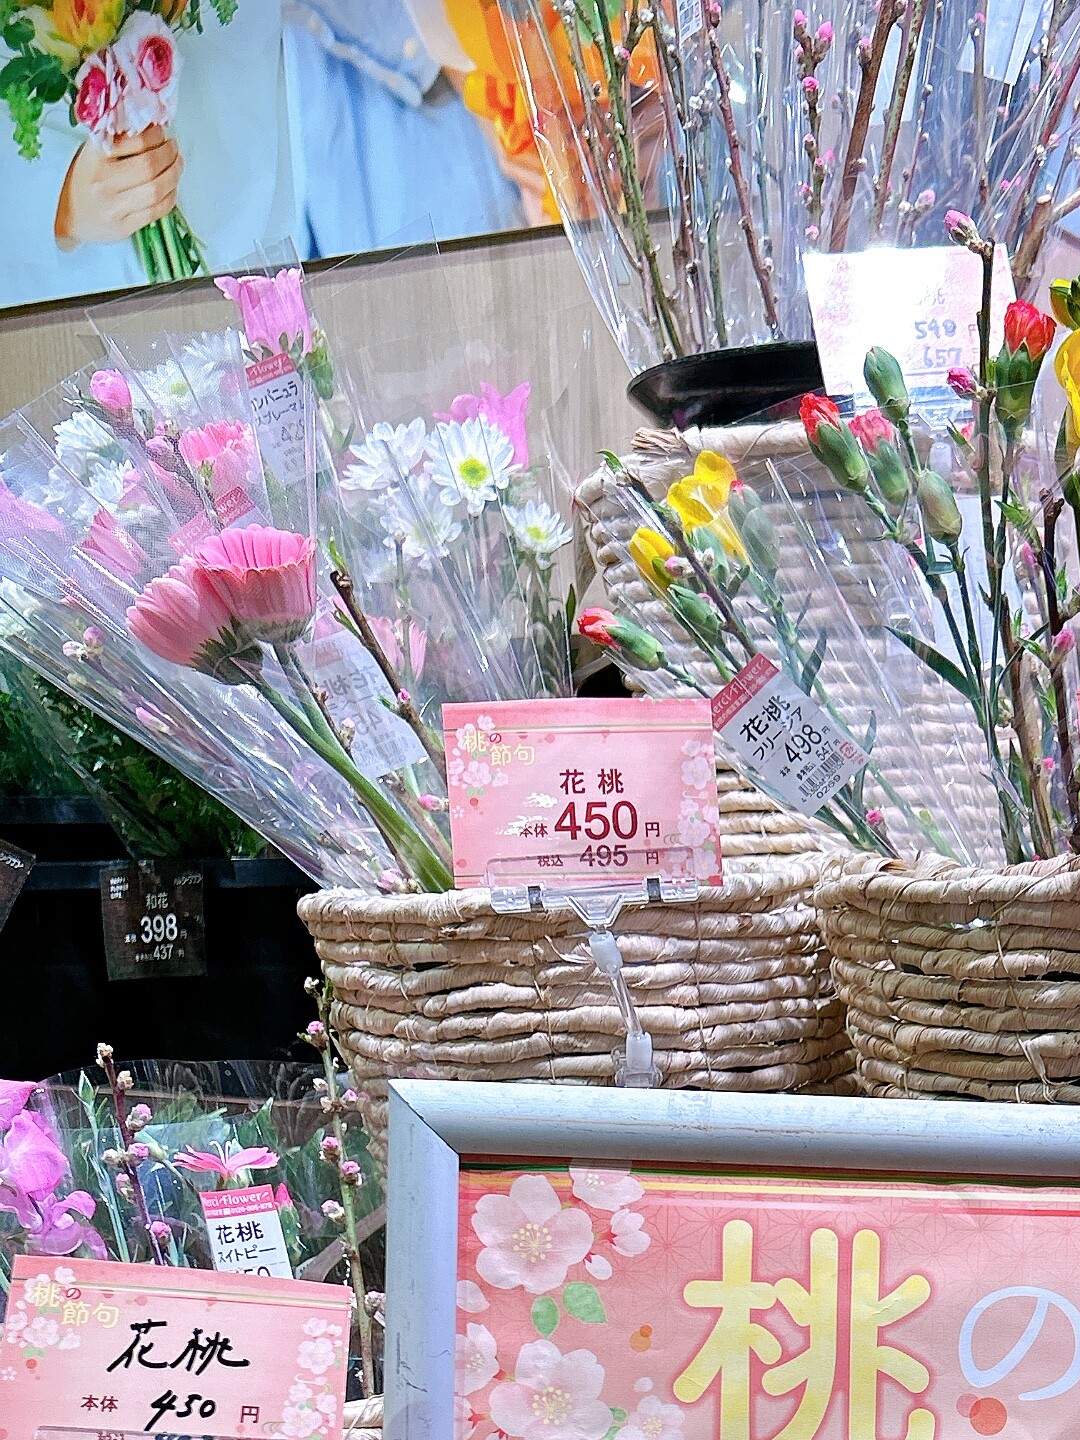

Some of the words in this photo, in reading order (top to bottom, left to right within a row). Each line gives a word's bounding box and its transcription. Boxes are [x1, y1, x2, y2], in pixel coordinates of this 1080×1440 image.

[739, 695, 791, 743] 花桃
[463, 730, 502, 753] 桃の
[753, 706, 802, 761] フリージア
[785, 724, 822, 763] 498
[490, 744, 535, 766] 節句
[815, 740, 834, 762] 547
[559, 768, 624, 795] 花桃
[519, 823, 548, 838] 本体
[554, 800, 639, 841] 450
[645, 821, 661, 838] 円
[537, 854, 564, 867] 税込
[579, 844, 629, 867] 495
[646, 851, 660, 865] 円
[140, 912, 178, 944] 398
[153, 943, 174, 960] 437
[216, 1221, 264, 1245] 花桃
[218, 1244, 277, 1263] スイトピー
[33, 1283, 82, 1308] 桃の
[60, 1301, 120, 1329] 節句
[106, 1318, 251, 1376] 花桃
[80, 1394, 119, 1412] 本体
[144, 1389, 217, 1432] 450
[240, 1405, 260, 1424] 円
